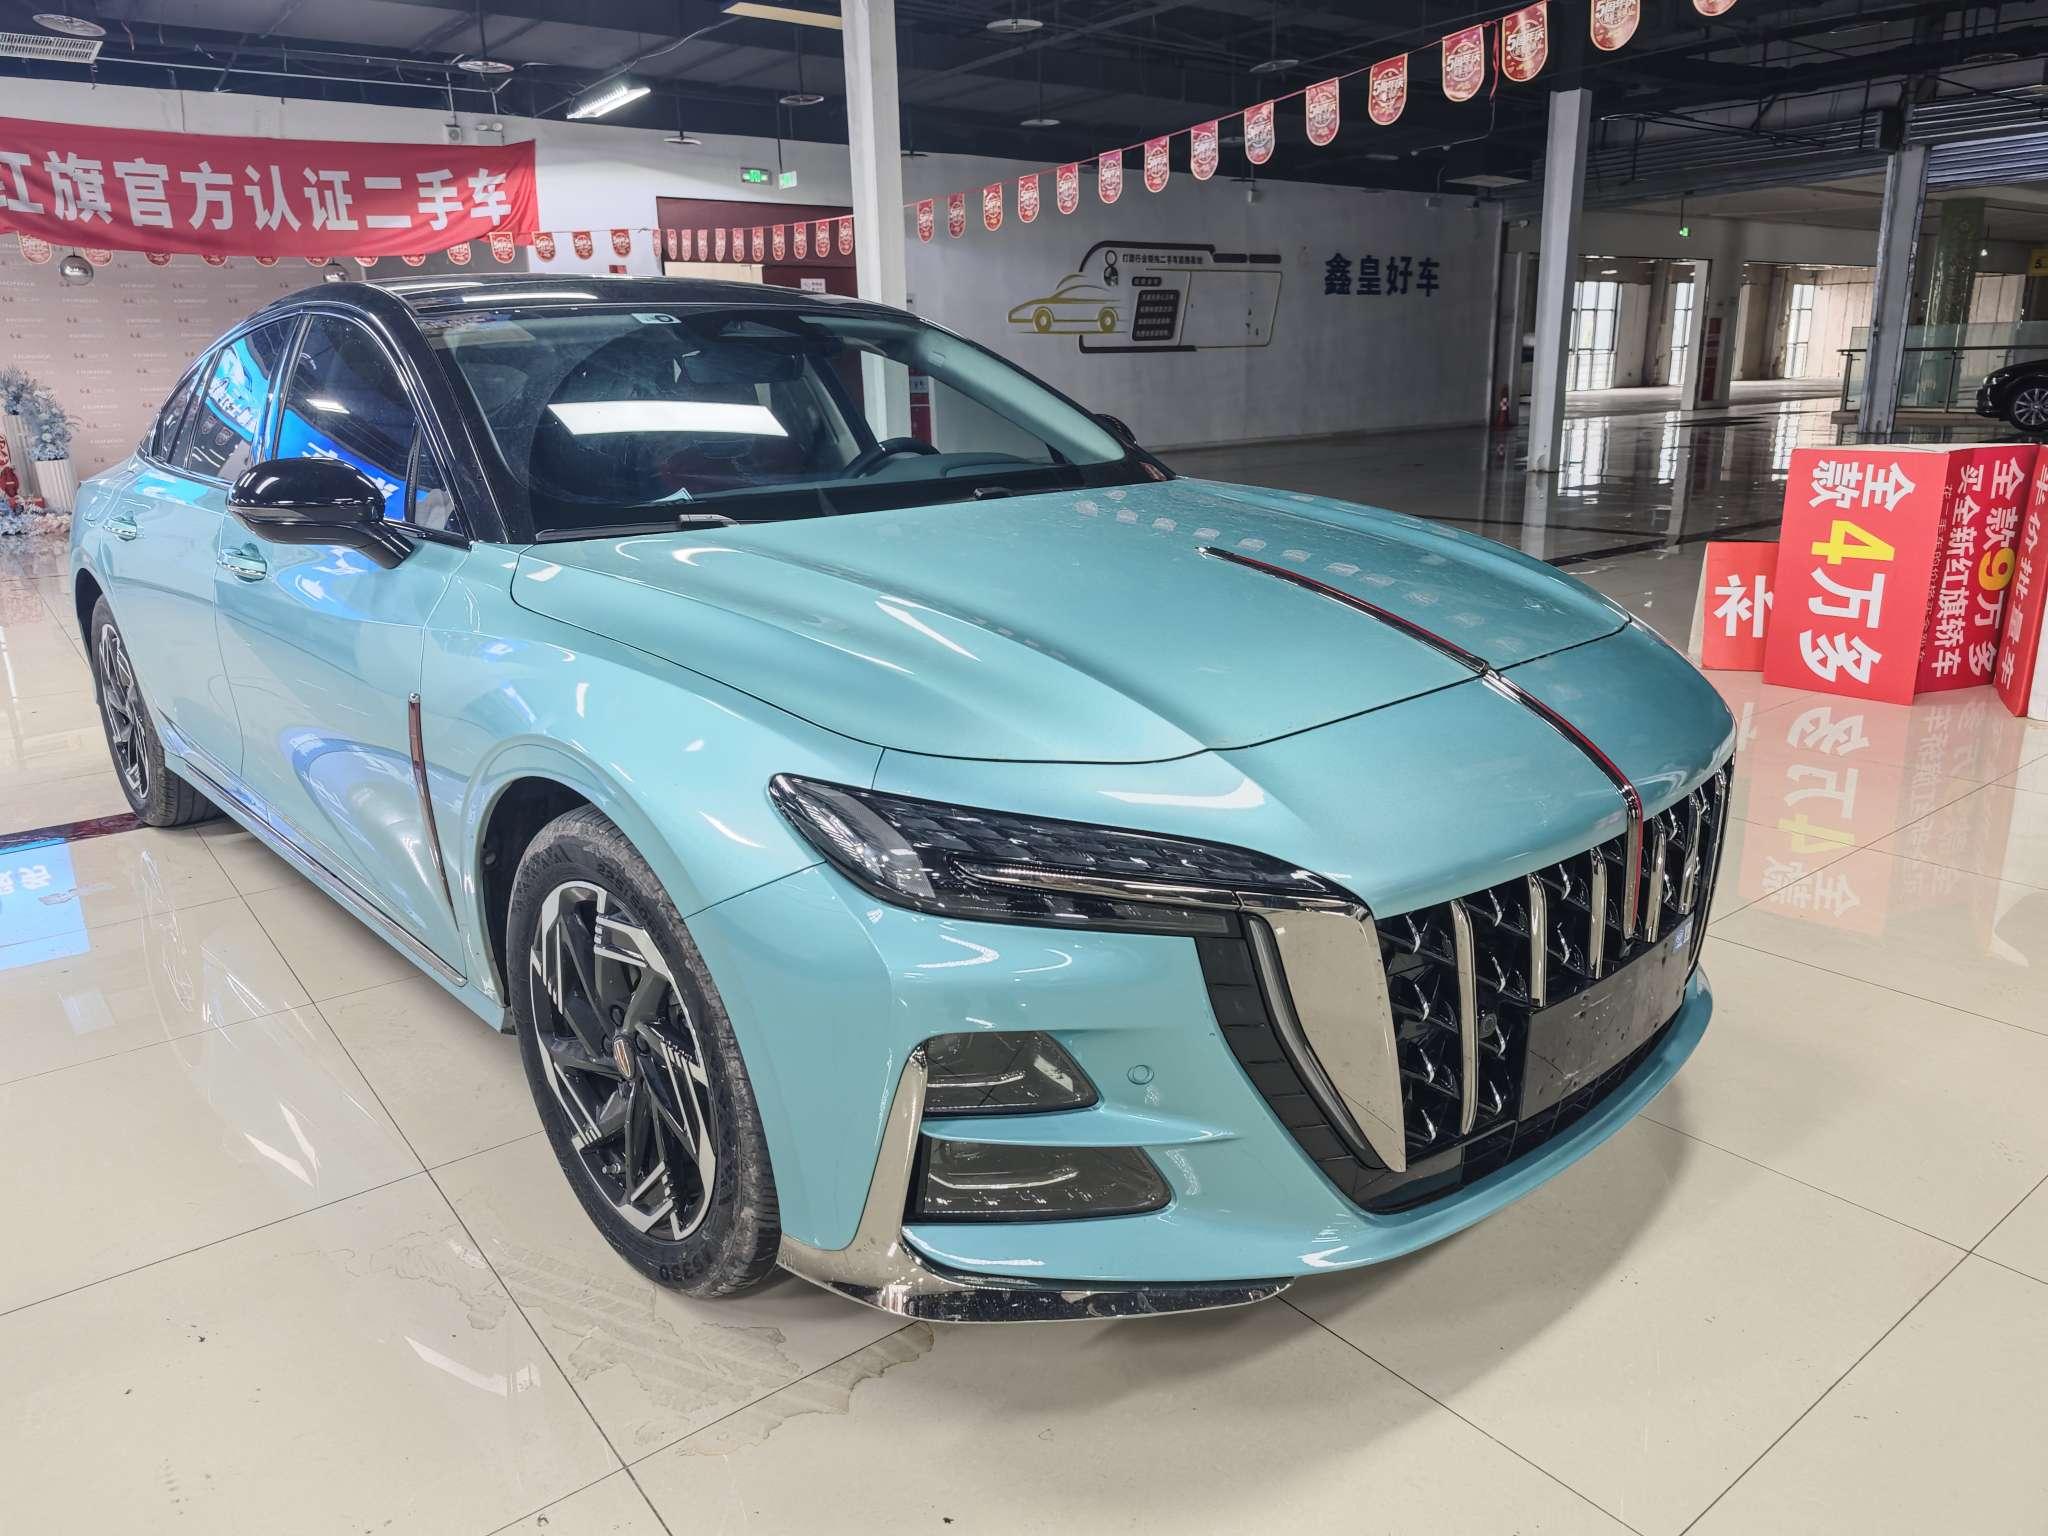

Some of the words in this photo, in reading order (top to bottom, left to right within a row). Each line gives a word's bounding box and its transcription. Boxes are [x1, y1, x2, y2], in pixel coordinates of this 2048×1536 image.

[0, 151, 511, 231] 红旗官方认证二手车
[1324, 252, 1440, 297] 鑫皇好车
[1930, 463, 1984, 678] 买全新红旗轿车
[1968, 457, 2026, 677] 全款9万多
